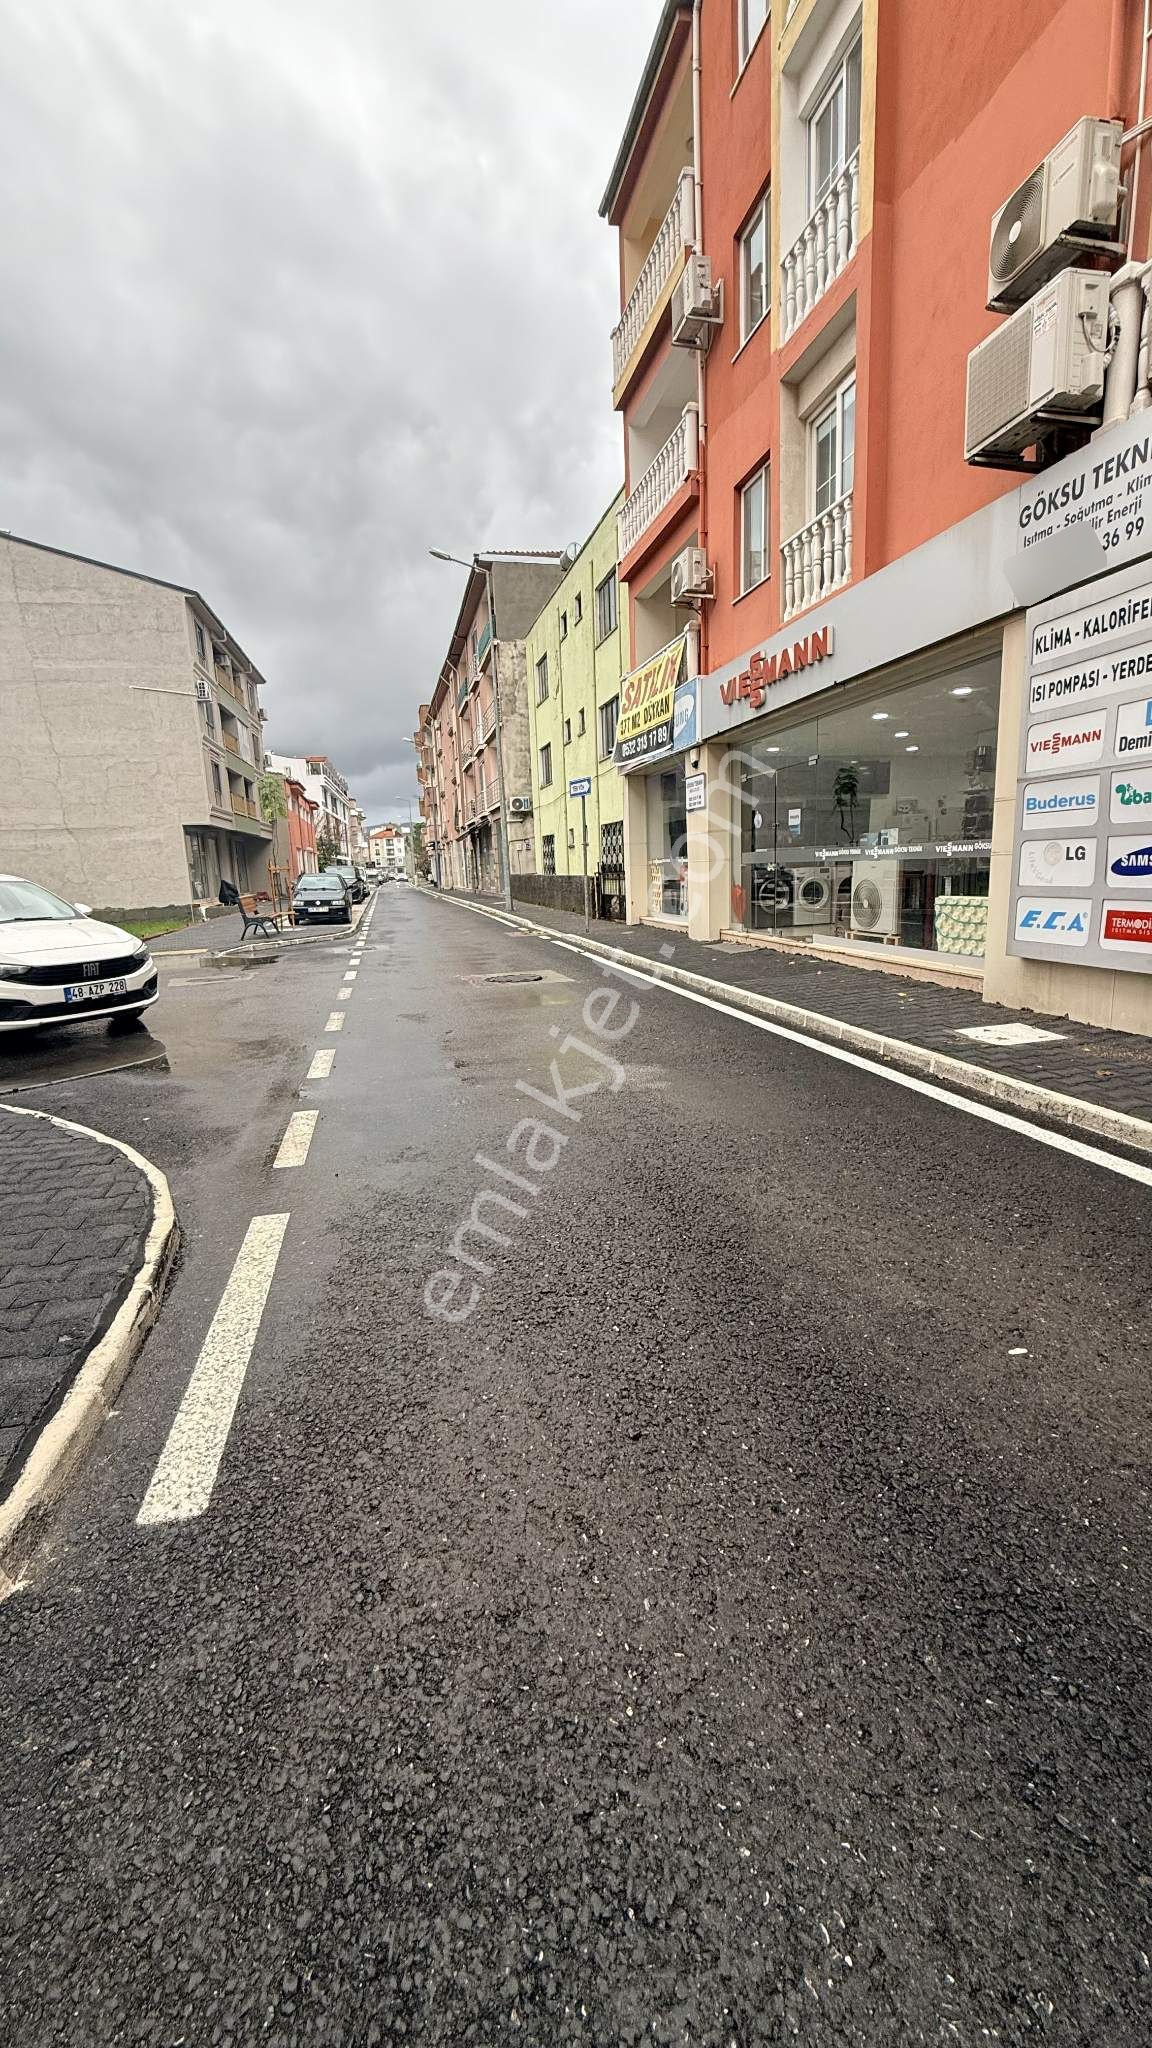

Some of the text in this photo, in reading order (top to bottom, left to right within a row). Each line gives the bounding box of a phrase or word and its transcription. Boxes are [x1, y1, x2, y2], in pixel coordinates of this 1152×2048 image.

[1019, 437, 1152, 529] GÖKSU TEKN
[1023, 524, 1053, 549] Isıtma
[1064, 494, 1114, 528] Soğutma
[1106, 494, 1144, 525] Enerji
[1102, 517, 1145, 552] 36 99
[1034, 625, 1071, 656] KLİMA
[1083, 597, 1152, 639] KALORİFE
[720, 624, 833, 709] VIESSMANN
[621, 651, 681, 716] SATILIK
[1031, 681, 1046, 703] ISI
[1048, 668, 1100, 700] POMPASI
[643, 694, 670, 726] DÜKKAN
[622, 740, 636, 758] 0532
[648, 730, 657, 747] 17
[657, 725, 667, 743] 89
[1030, 729, 1102, 755] VIESSMANN
[1025, 792, 1096, 812] Buderus
[935, 842, 974, 857] VIESSMANN
[1065, 845, 1087, 861] LG
[82, 962, 101, 977] FIAT
[72, 980, 125, 999] 48 AZP 228
